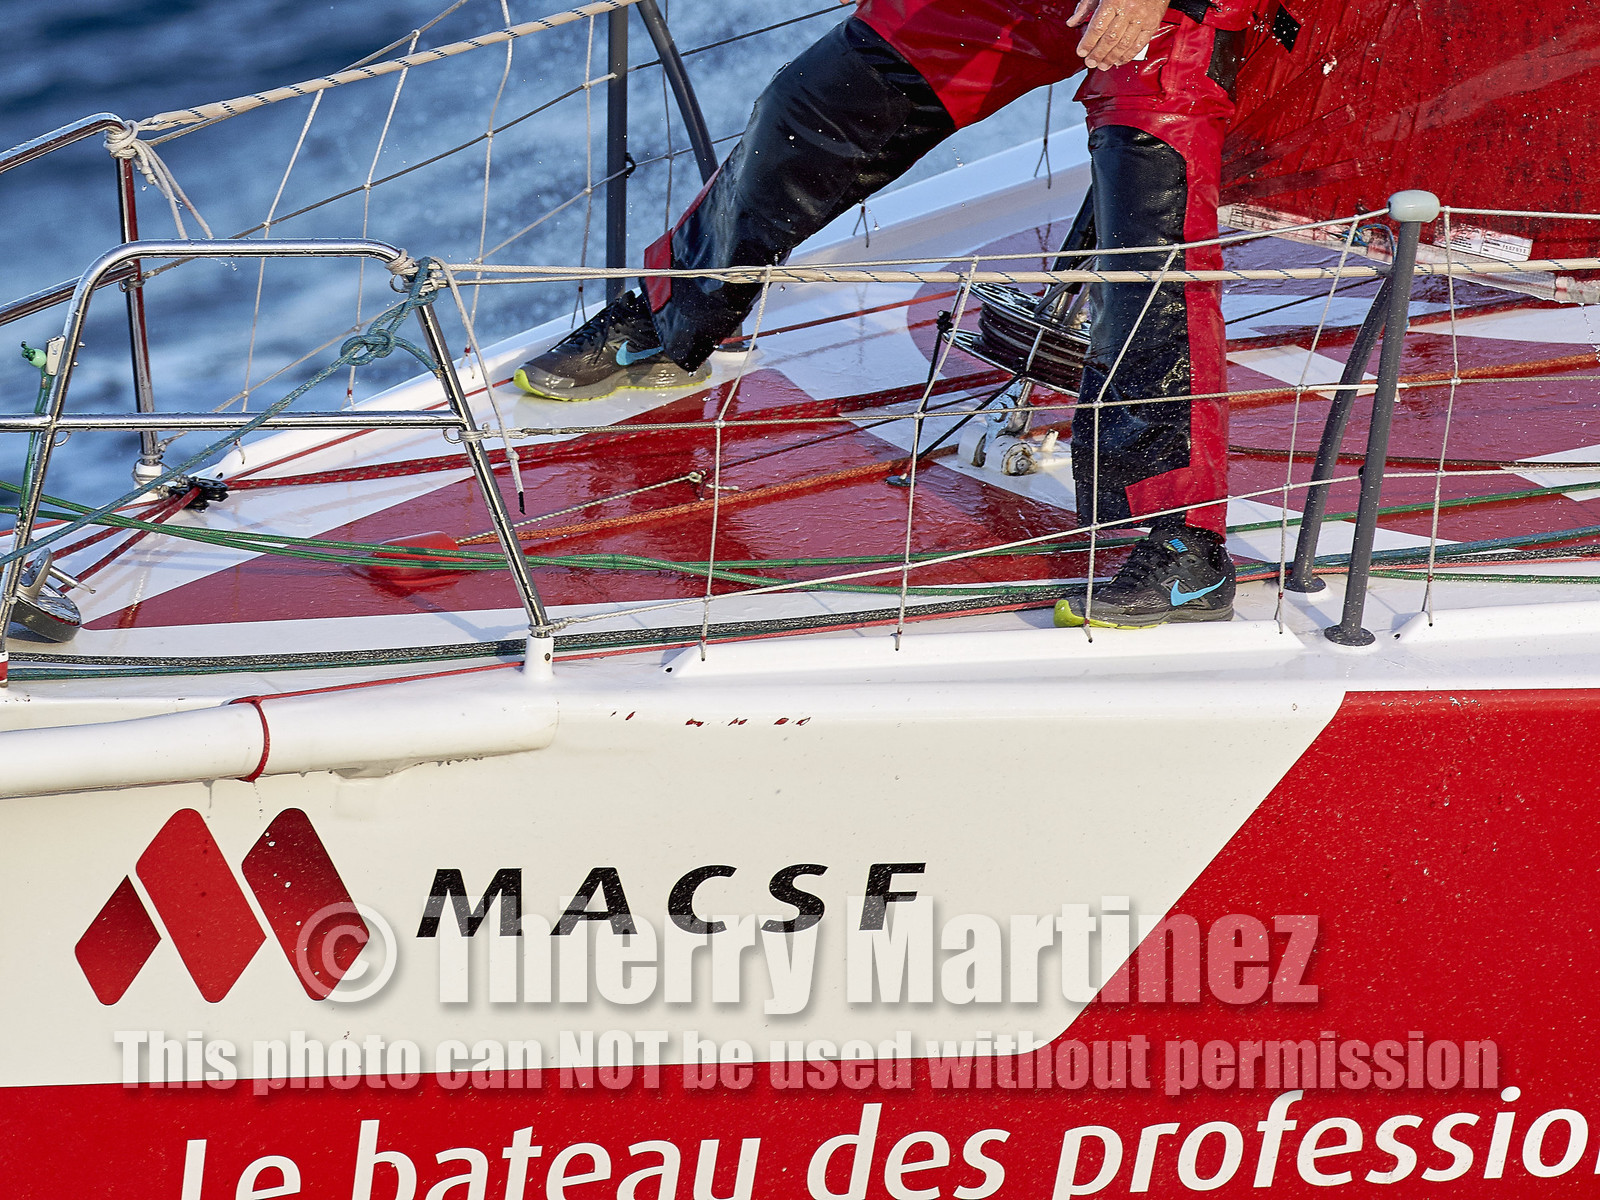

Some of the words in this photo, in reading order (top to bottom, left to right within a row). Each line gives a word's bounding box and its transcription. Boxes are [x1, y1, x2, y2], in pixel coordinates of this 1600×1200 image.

[416, 862, 927, 938] MACSF
[353, 1119, 762, 1200] bateau
[806, 1103, 1011, 1200] des
[1048, 1086, 1600, 1200] professio
